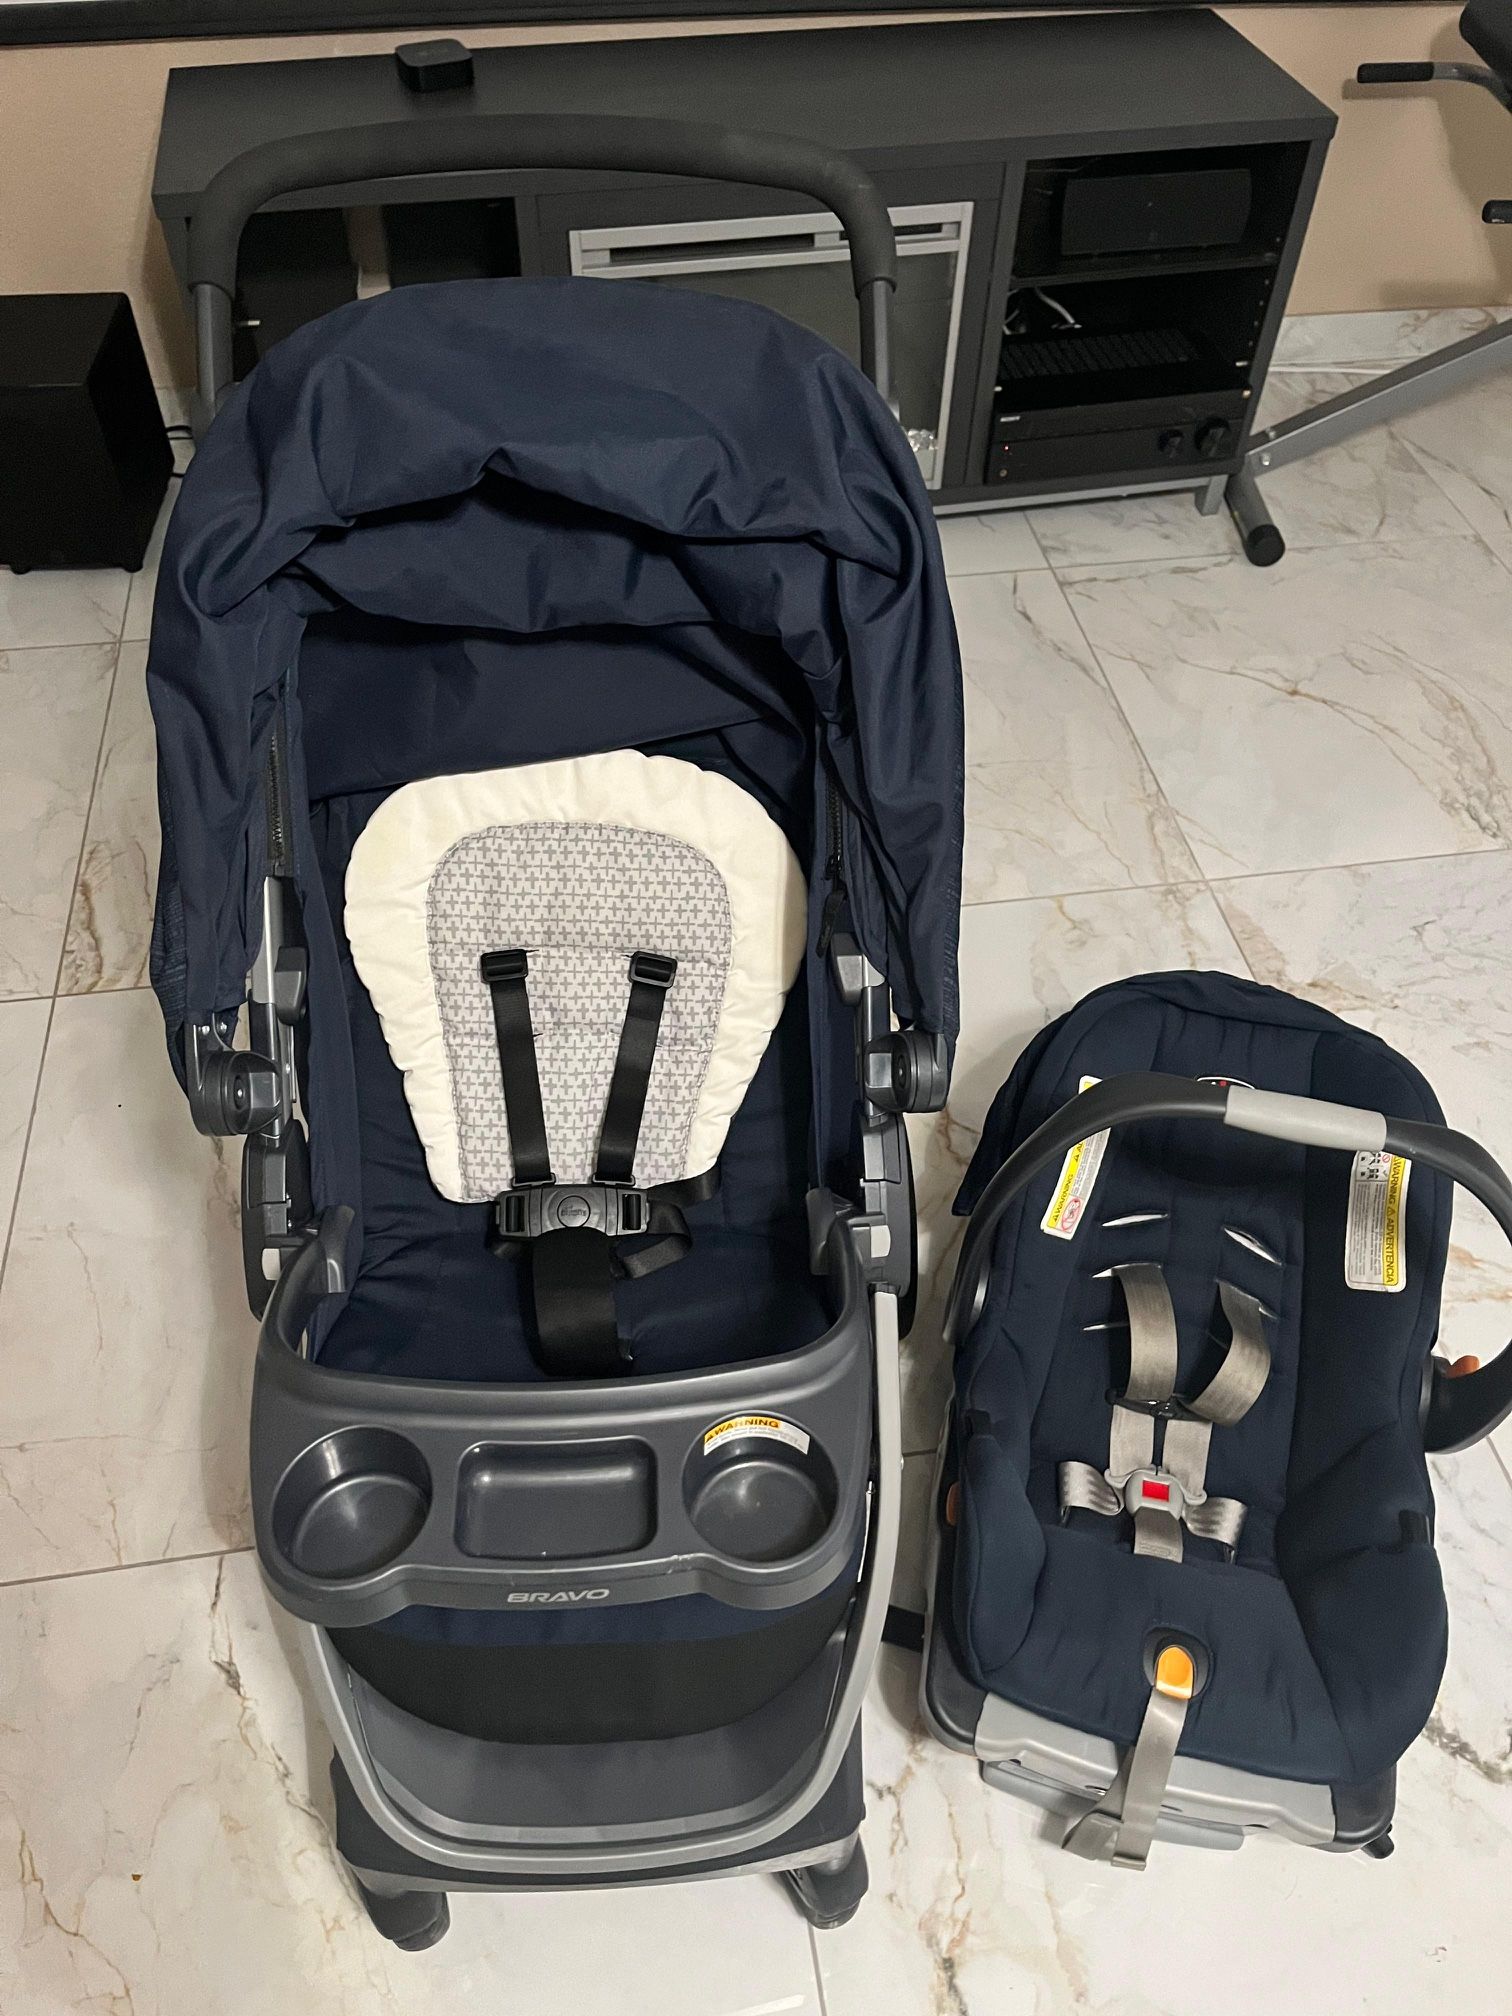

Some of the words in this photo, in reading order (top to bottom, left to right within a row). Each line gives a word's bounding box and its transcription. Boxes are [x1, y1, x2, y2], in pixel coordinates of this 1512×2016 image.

[1056, 1173, 1074, 1214] WARNING
[1387, 1161, 1402, 1205] WARNING
[1386, 1218, 1396, 1283] ADVERTENCIA
[507, 1588, 610, 1603] BRAVO
